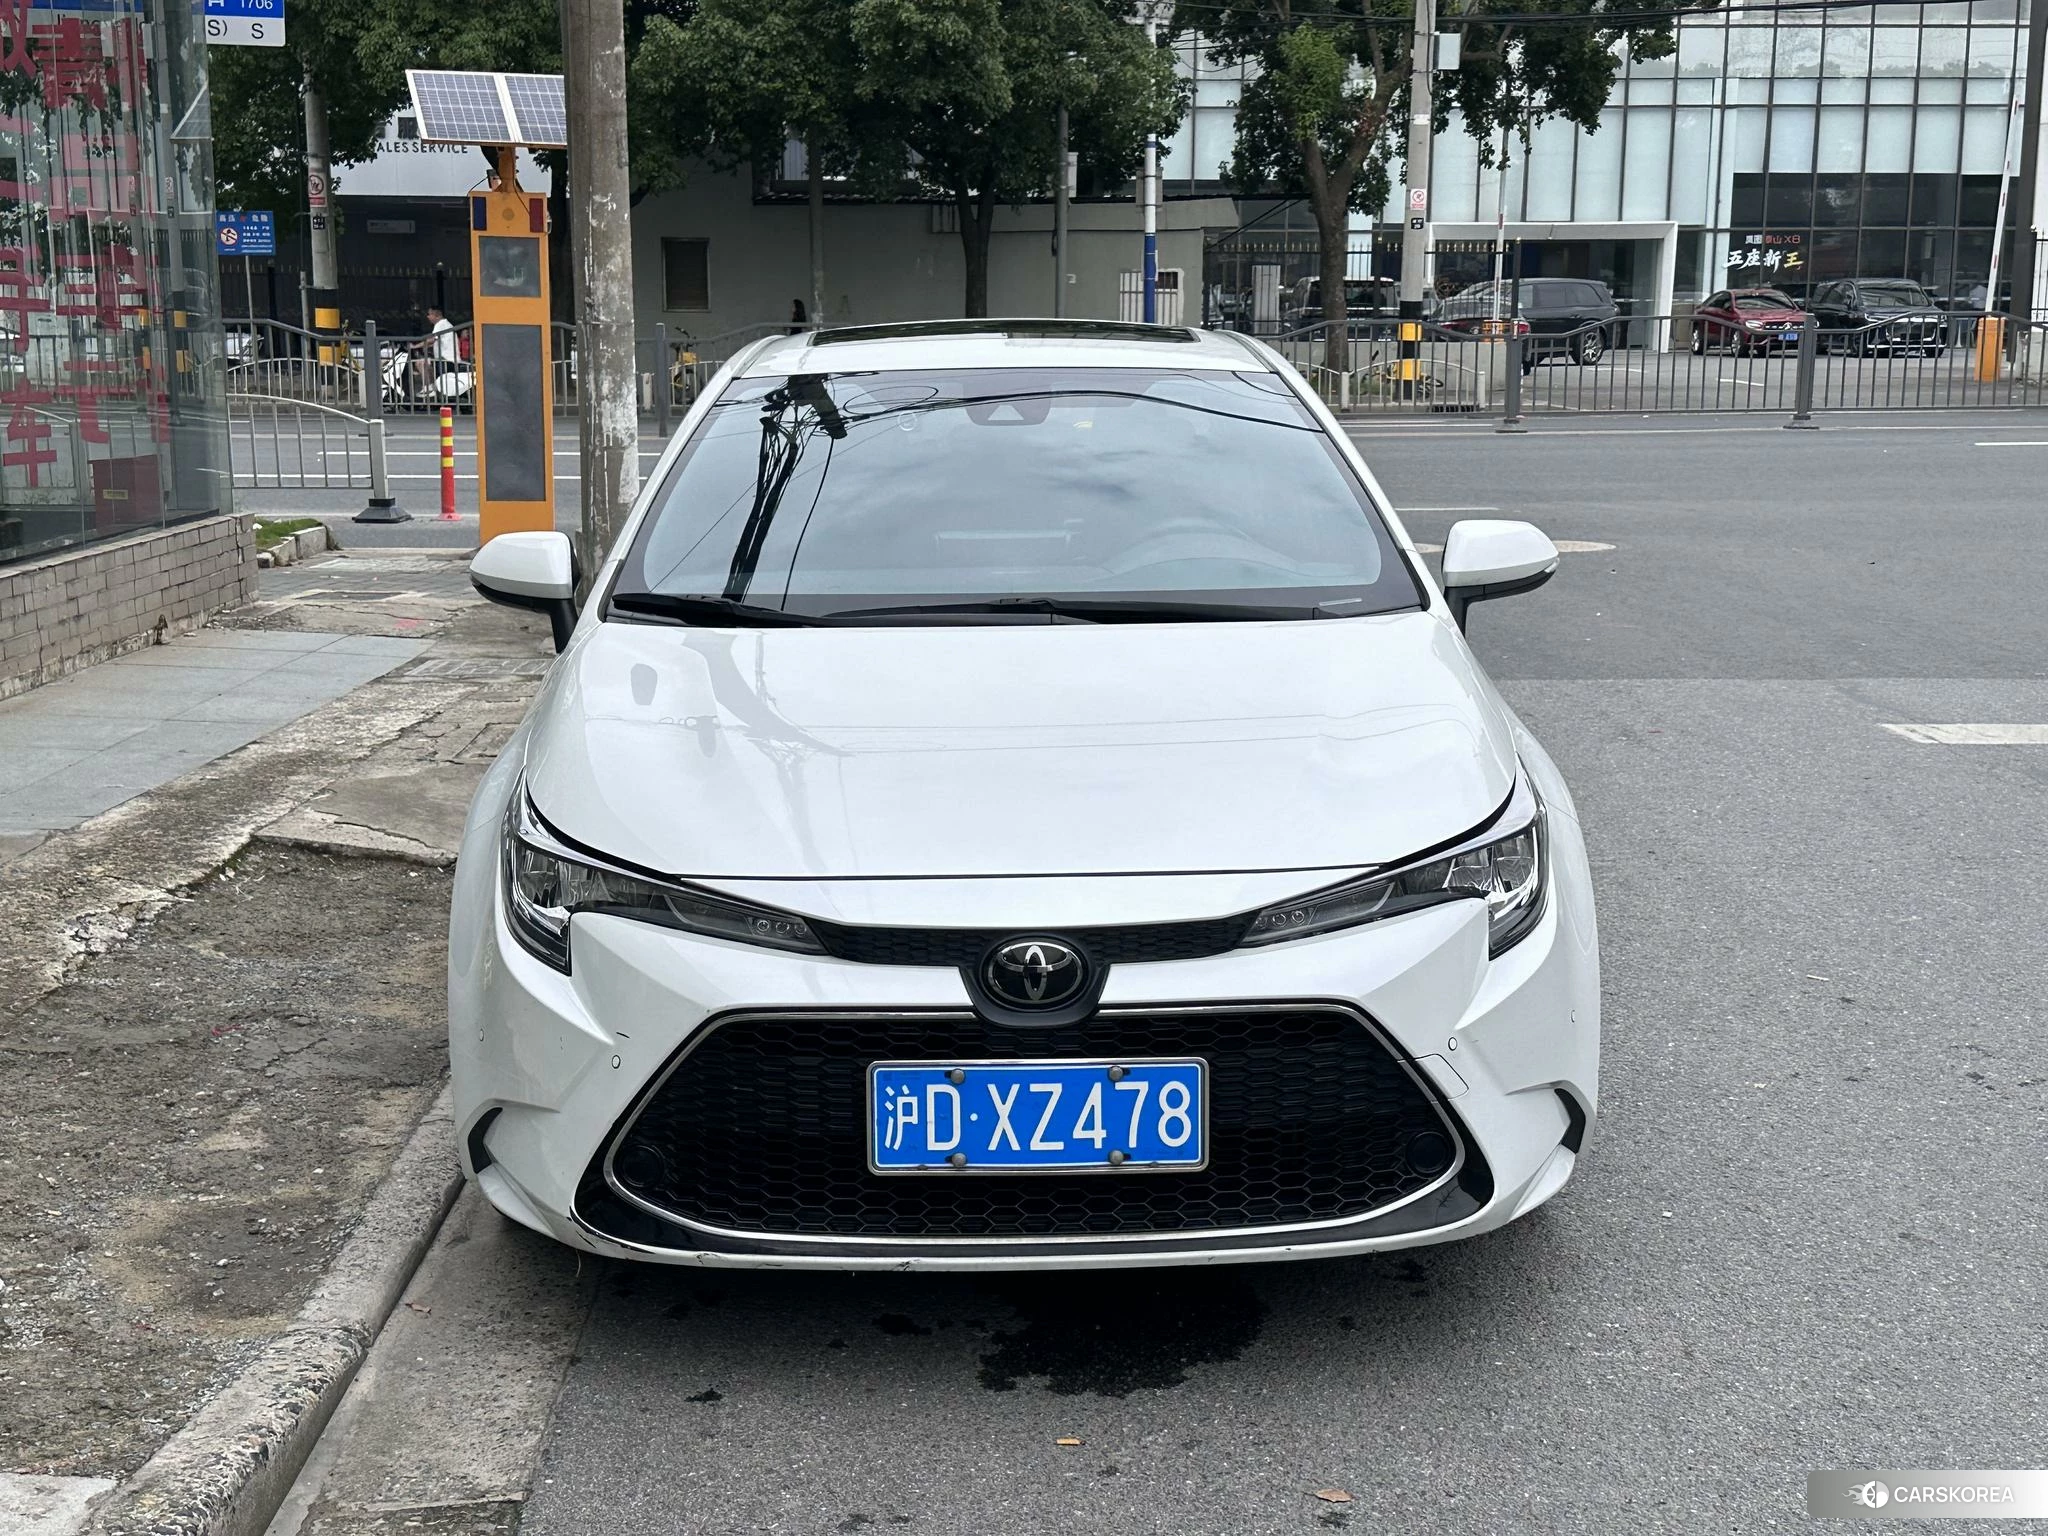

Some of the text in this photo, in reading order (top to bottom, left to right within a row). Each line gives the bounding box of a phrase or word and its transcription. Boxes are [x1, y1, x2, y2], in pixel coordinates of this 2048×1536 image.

[251, 23, 264, 39] S
[377, 141, 468, 153] ALES SERVICE
[884, 1081, 1192, 1151] 沪D·XZ478
